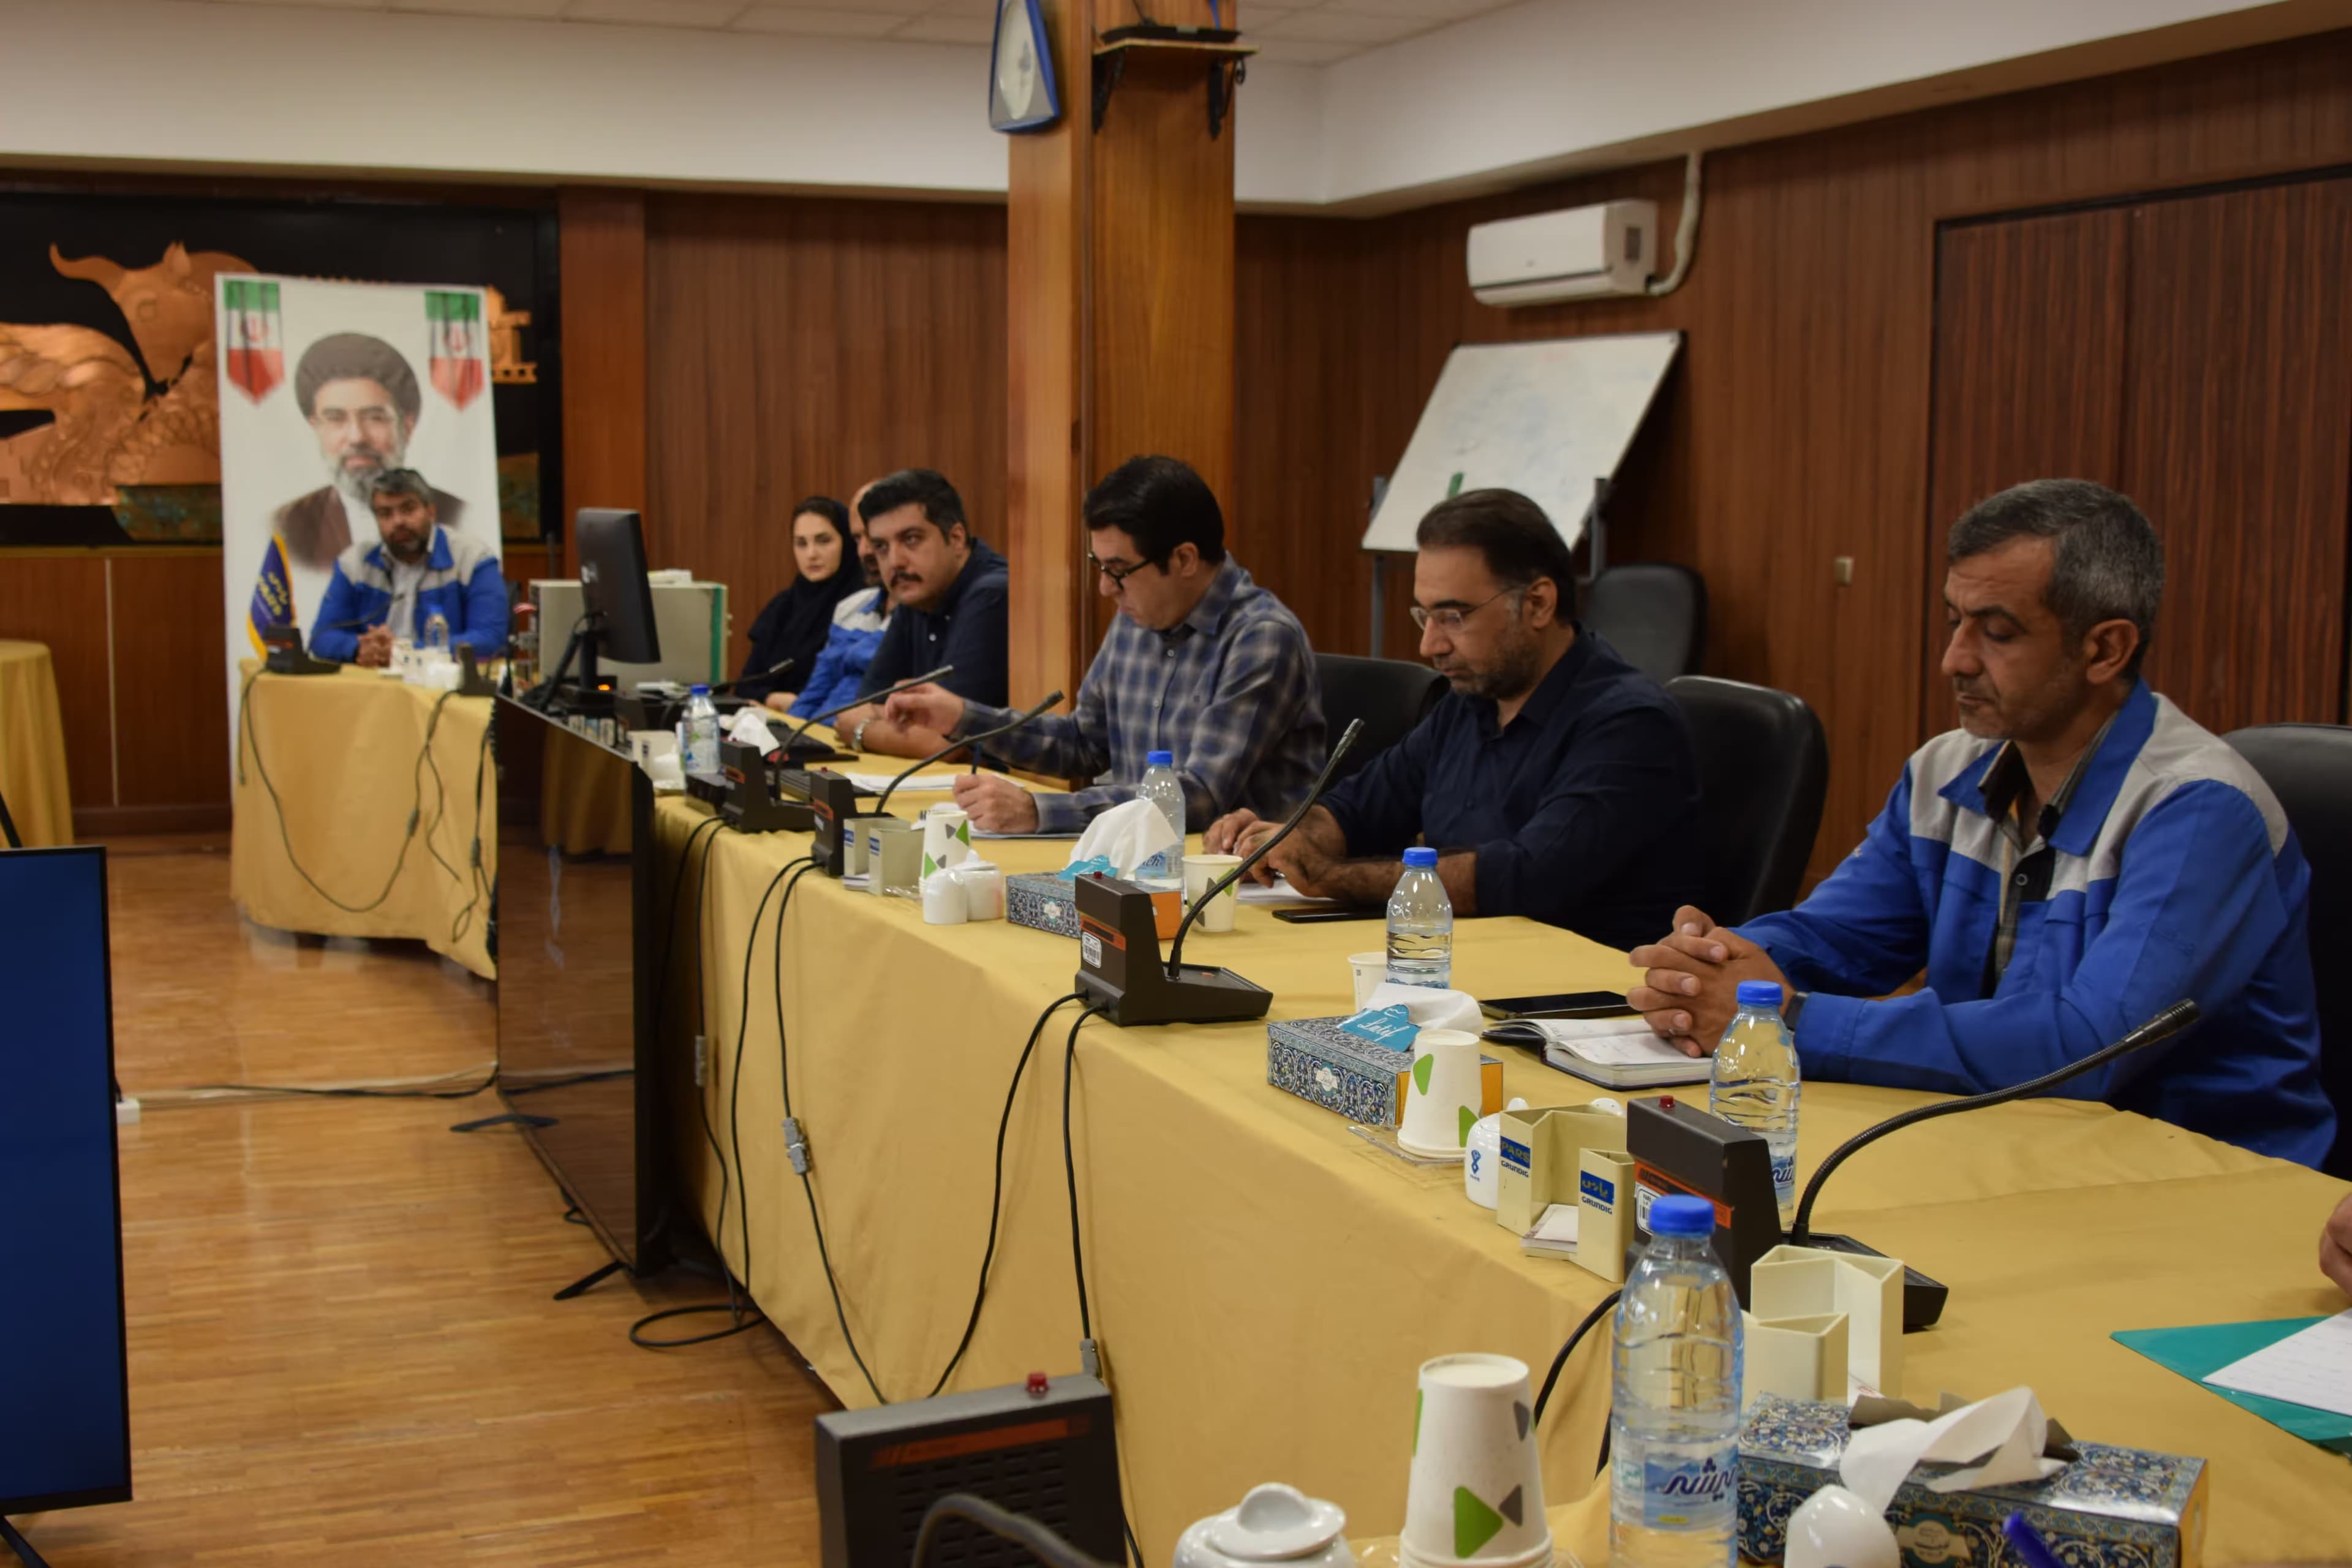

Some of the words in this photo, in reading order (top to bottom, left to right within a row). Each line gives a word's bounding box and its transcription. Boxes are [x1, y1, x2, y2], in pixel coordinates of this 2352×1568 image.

[1357, 1017, 1410, 1042] Latif
[1501, 1140, 1530, 1164] PARS
[1501, 1159, 1529, 1178] GRUNDIG
[1581, 1196, 1613, 1215] GRUNDIG
